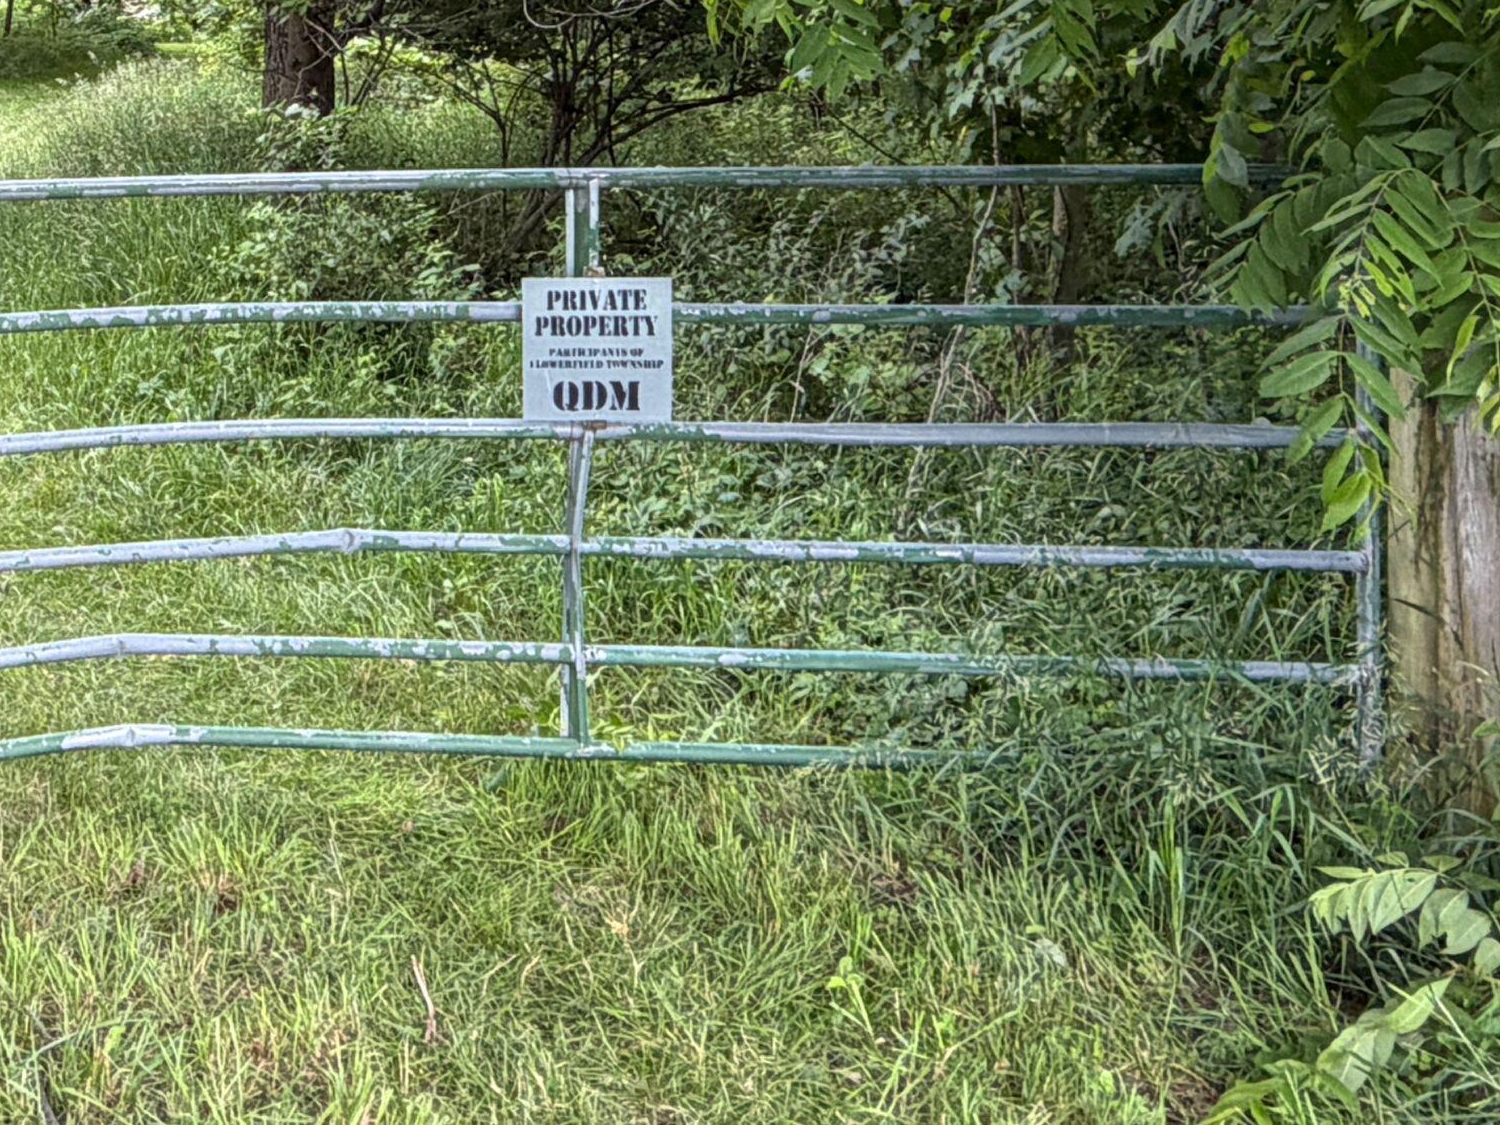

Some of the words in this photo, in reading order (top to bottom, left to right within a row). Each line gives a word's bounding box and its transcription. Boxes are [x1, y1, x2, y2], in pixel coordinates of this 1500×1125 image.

[546, 289, 647, 311] PRIVATE
[535, 315, 658, 337] PROPERTY
[549, 347, 628, 357] PARTICIPANTS
[629, 347, 644, 357] OF
[606, 359, 664, 369] TOWNSHIP
[553, 380, 640, 411] QDM
